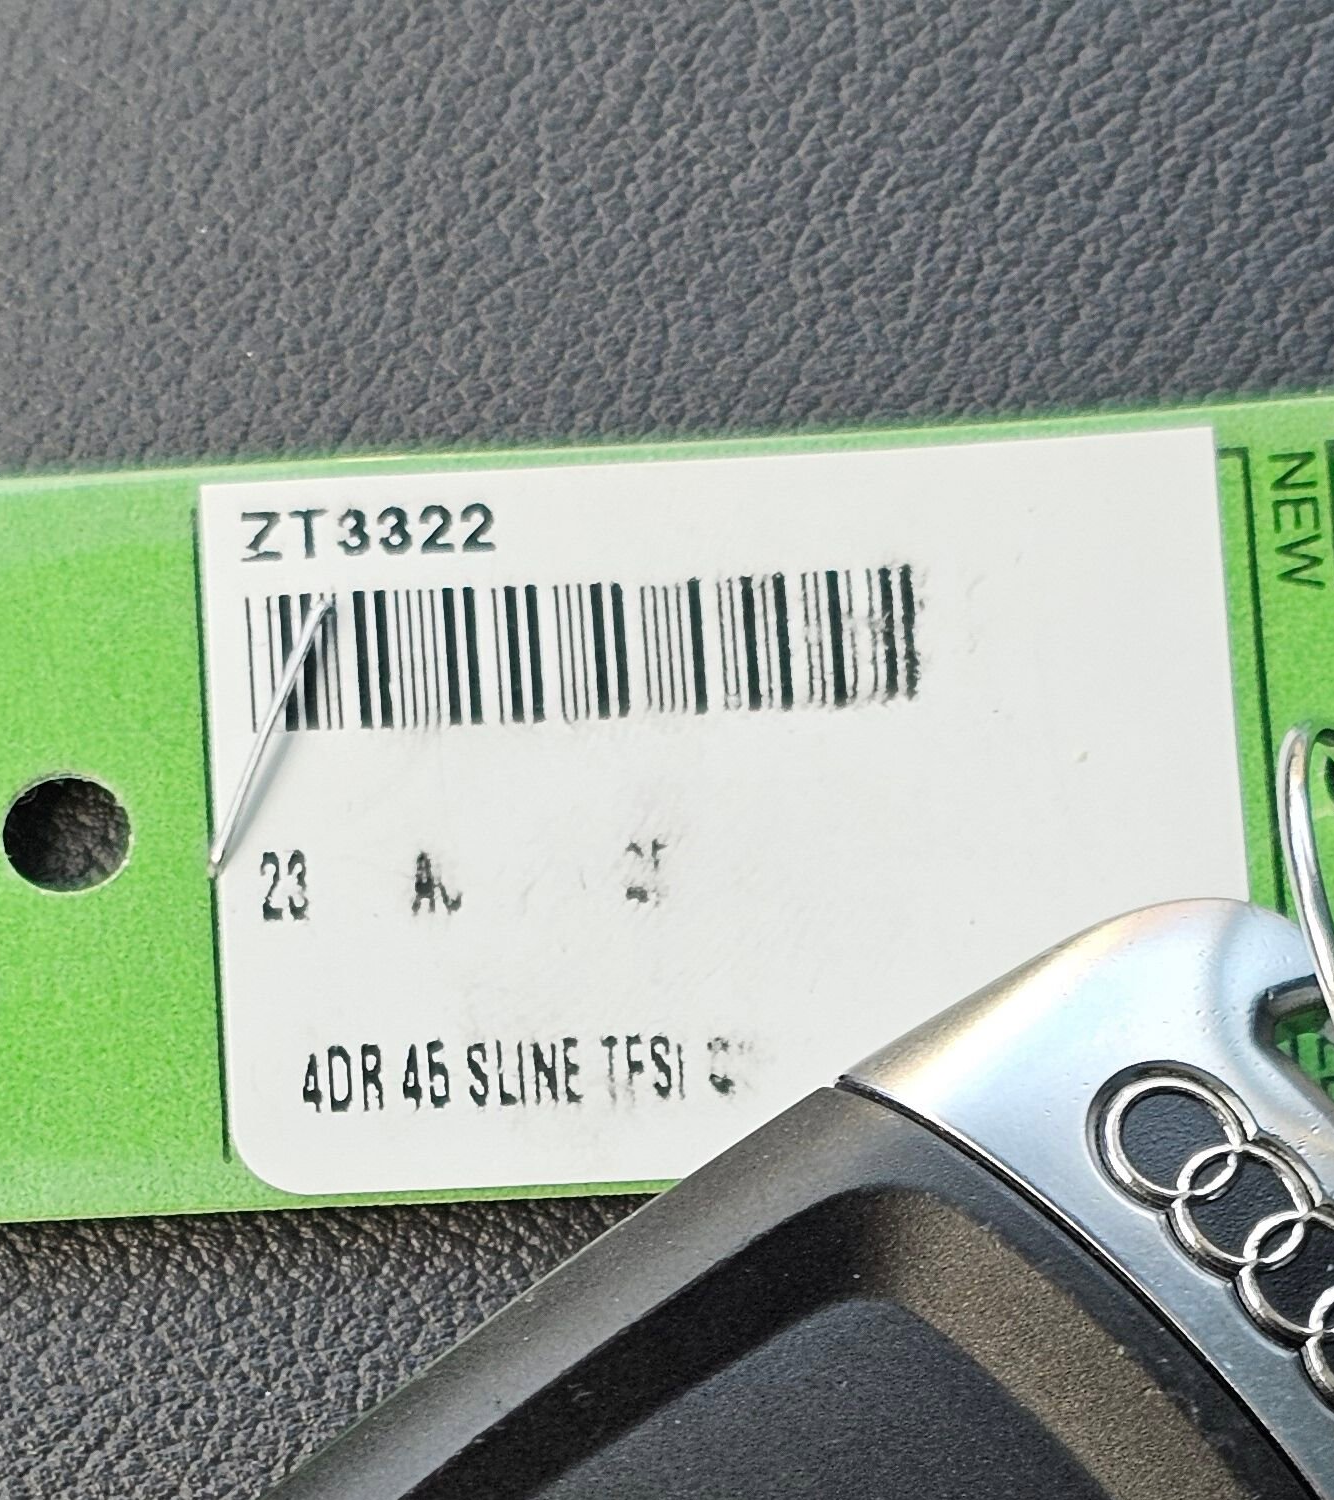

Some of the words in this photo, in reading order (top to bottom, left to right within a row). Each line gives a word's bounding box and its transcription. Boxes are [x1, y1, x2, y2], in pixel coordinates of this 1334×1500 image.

[240, 502, 497, 563] ZT3322
[1269, 449, 1325, 591] NEW
[259, 849, 309, 921] 23
[302, 1043, 384, 1113] 4DR
[402, 1037, 450, 1112] 45
[466, 1037, 584, 1108] SLINE
[600, 1033, 687, 1106] TFSI
